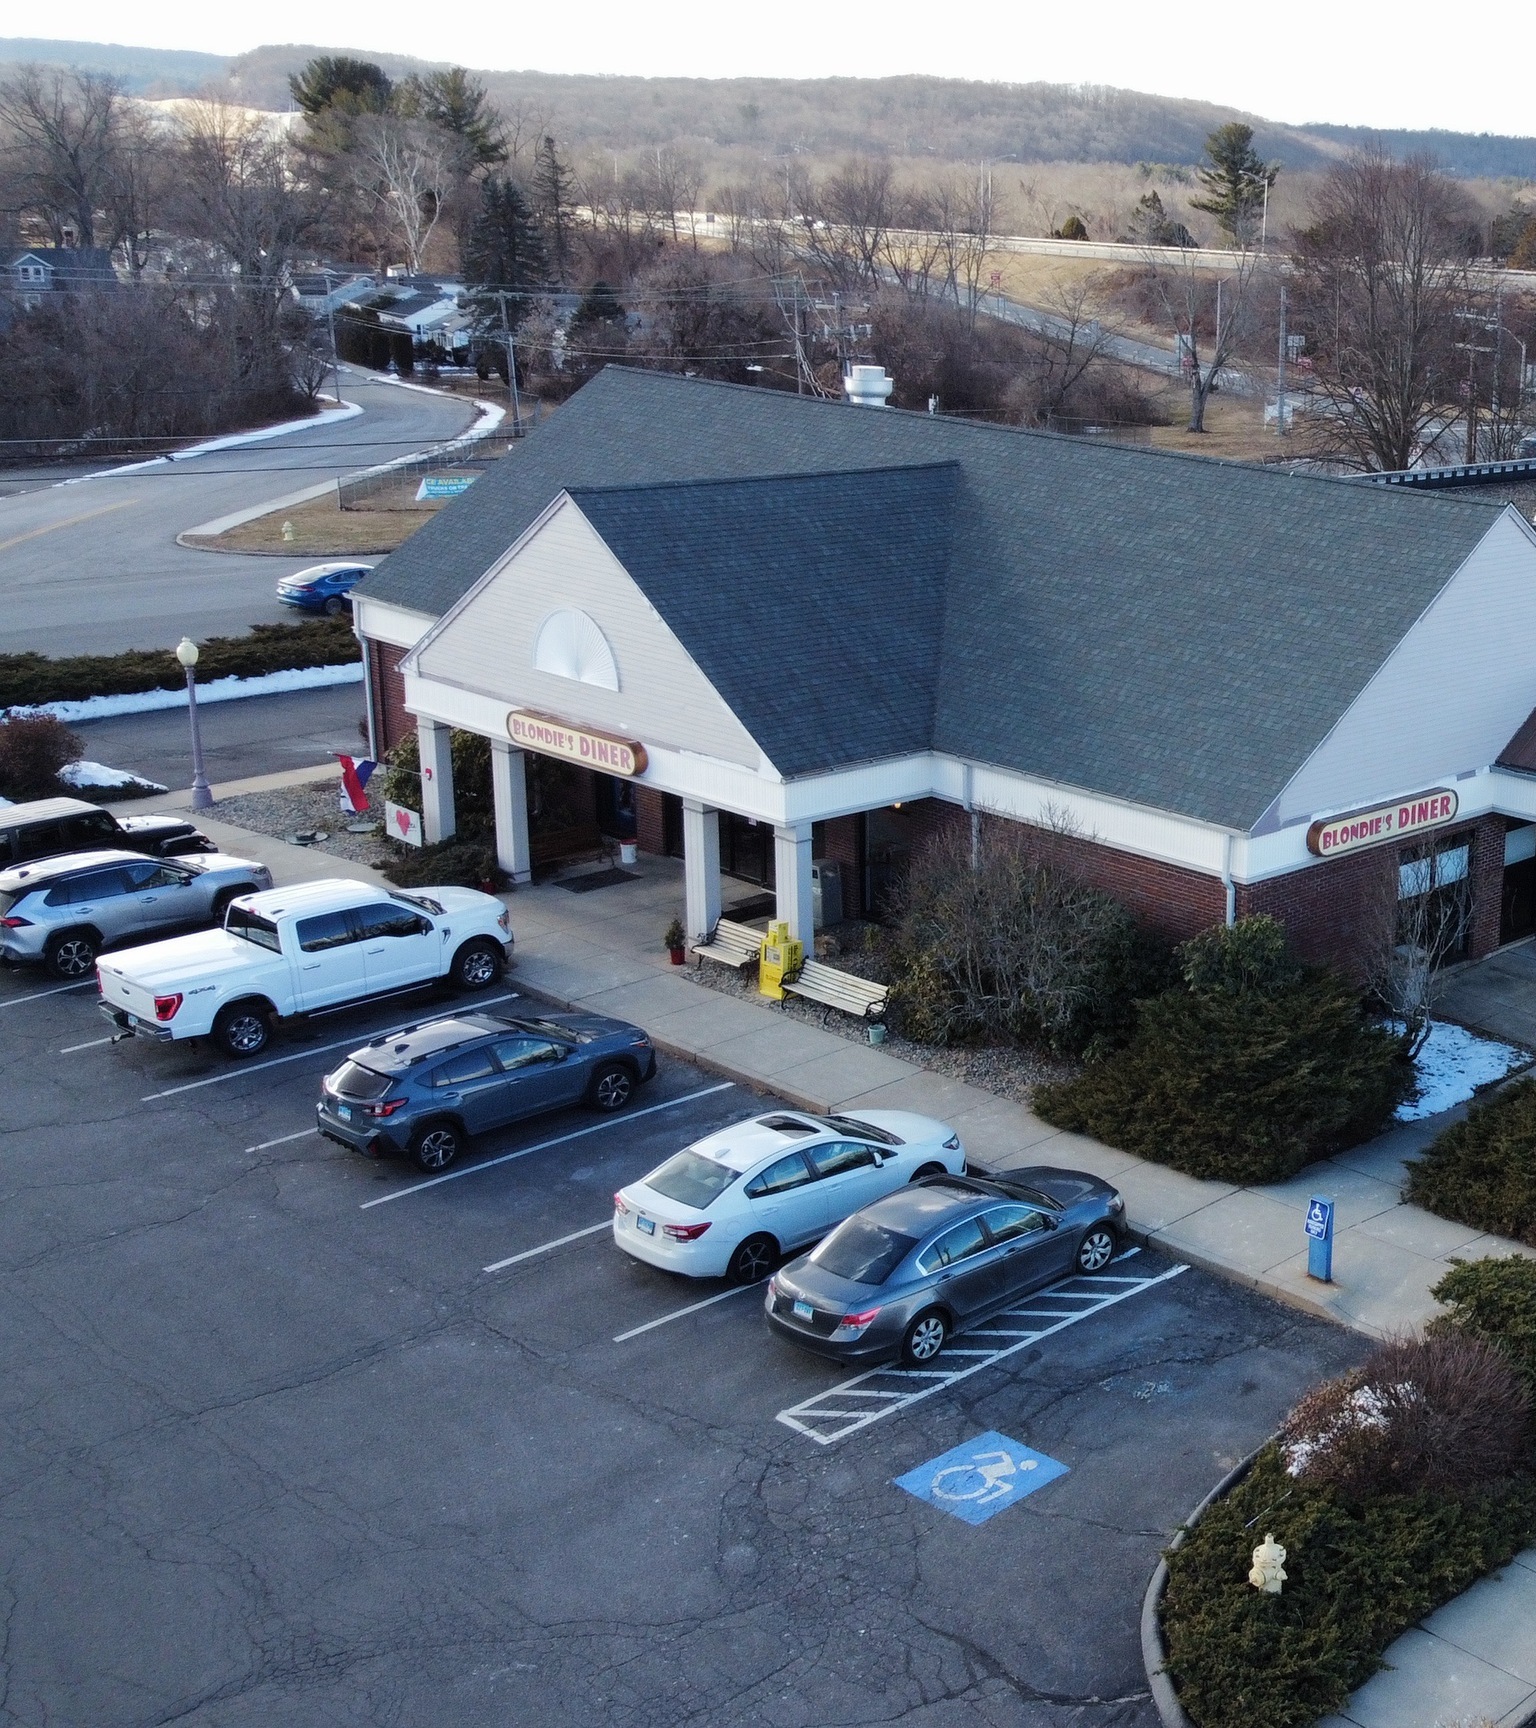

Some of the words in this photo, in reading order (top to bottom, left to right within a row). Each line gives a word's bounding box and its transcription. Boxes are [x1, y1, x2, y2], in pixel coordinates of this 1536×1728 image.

[512, 718, 574, 751] BLONDIE'S
[579, 736, 631, 770] DINER
[1322, 814, 1392, 850] BLONDIE'S
[1398, 795, 1451, 829] DINER
